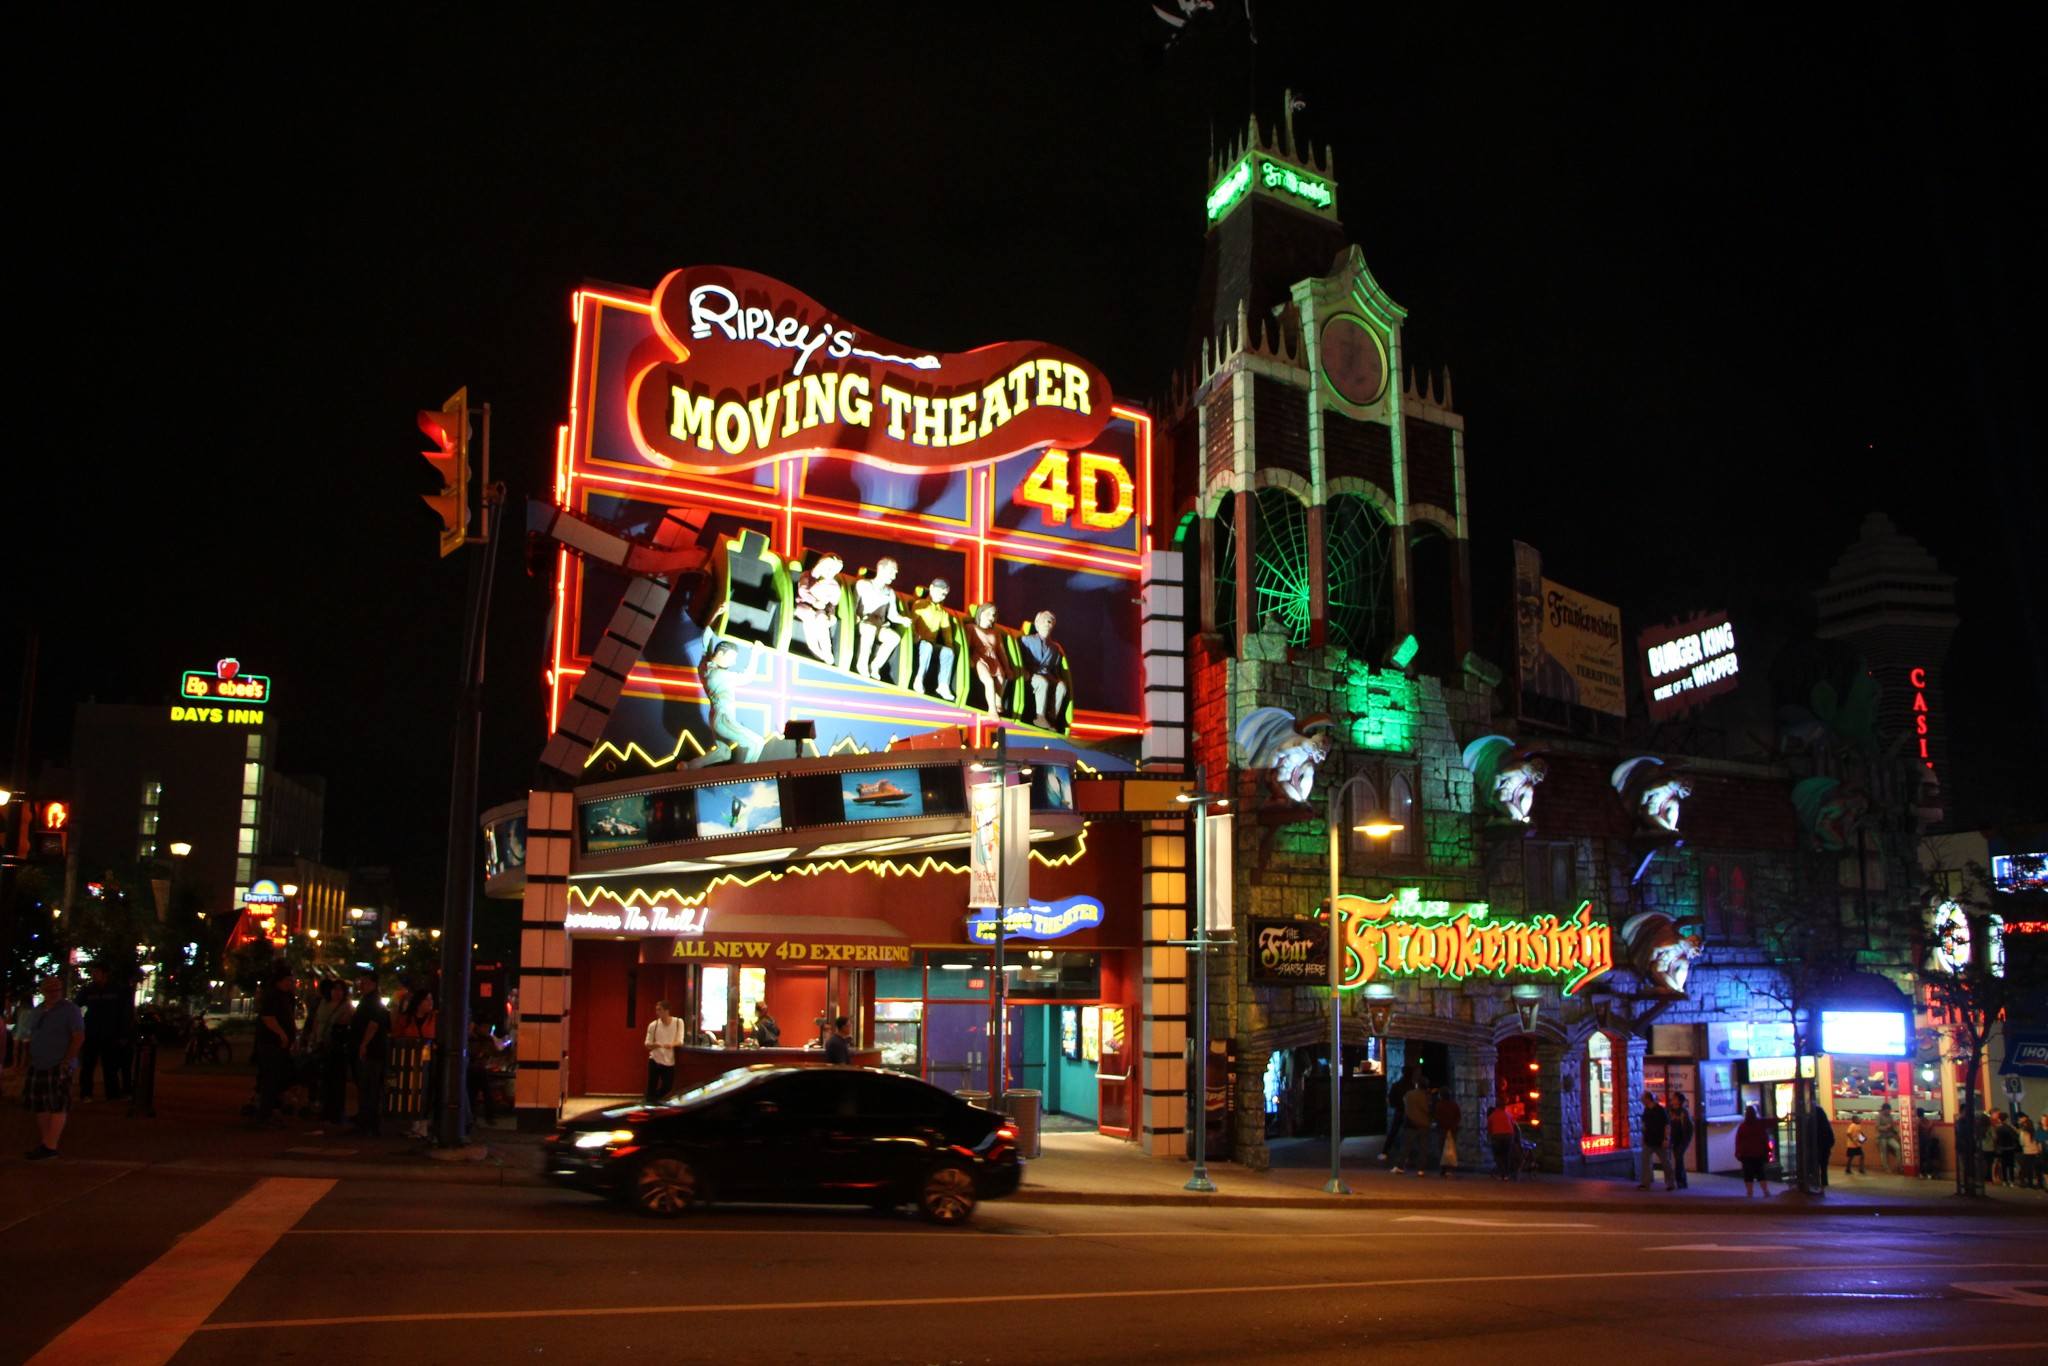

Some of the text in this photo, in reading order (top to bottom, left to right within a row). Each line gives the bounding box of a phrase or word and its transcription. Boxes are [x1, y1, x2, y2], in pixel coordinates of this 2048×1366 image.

[688, 284, 855, 377] Ripley's
[670, 358, 1092, 455] MOVING THEATER
[1022, 448, 1134, 529] 4D
[1648, 622, 1735, 677] BURGER KING
[1692, 652, 1739, 688] WHOPPER
[171, 706, 264, 725] DAYS INN
[1910, 668, 1934, 769] CASI
[244, 893, 268, 903] Days
[623, 906, 650, 930] The
[1033, 903, 1098, 935] THEATER
[672, 940, 710, 958] ALL
[713, 941, 772, 958] NEW
[775, 940, 807, 961] 4D
[1330, 894, 1614, 996] Frankenstein
